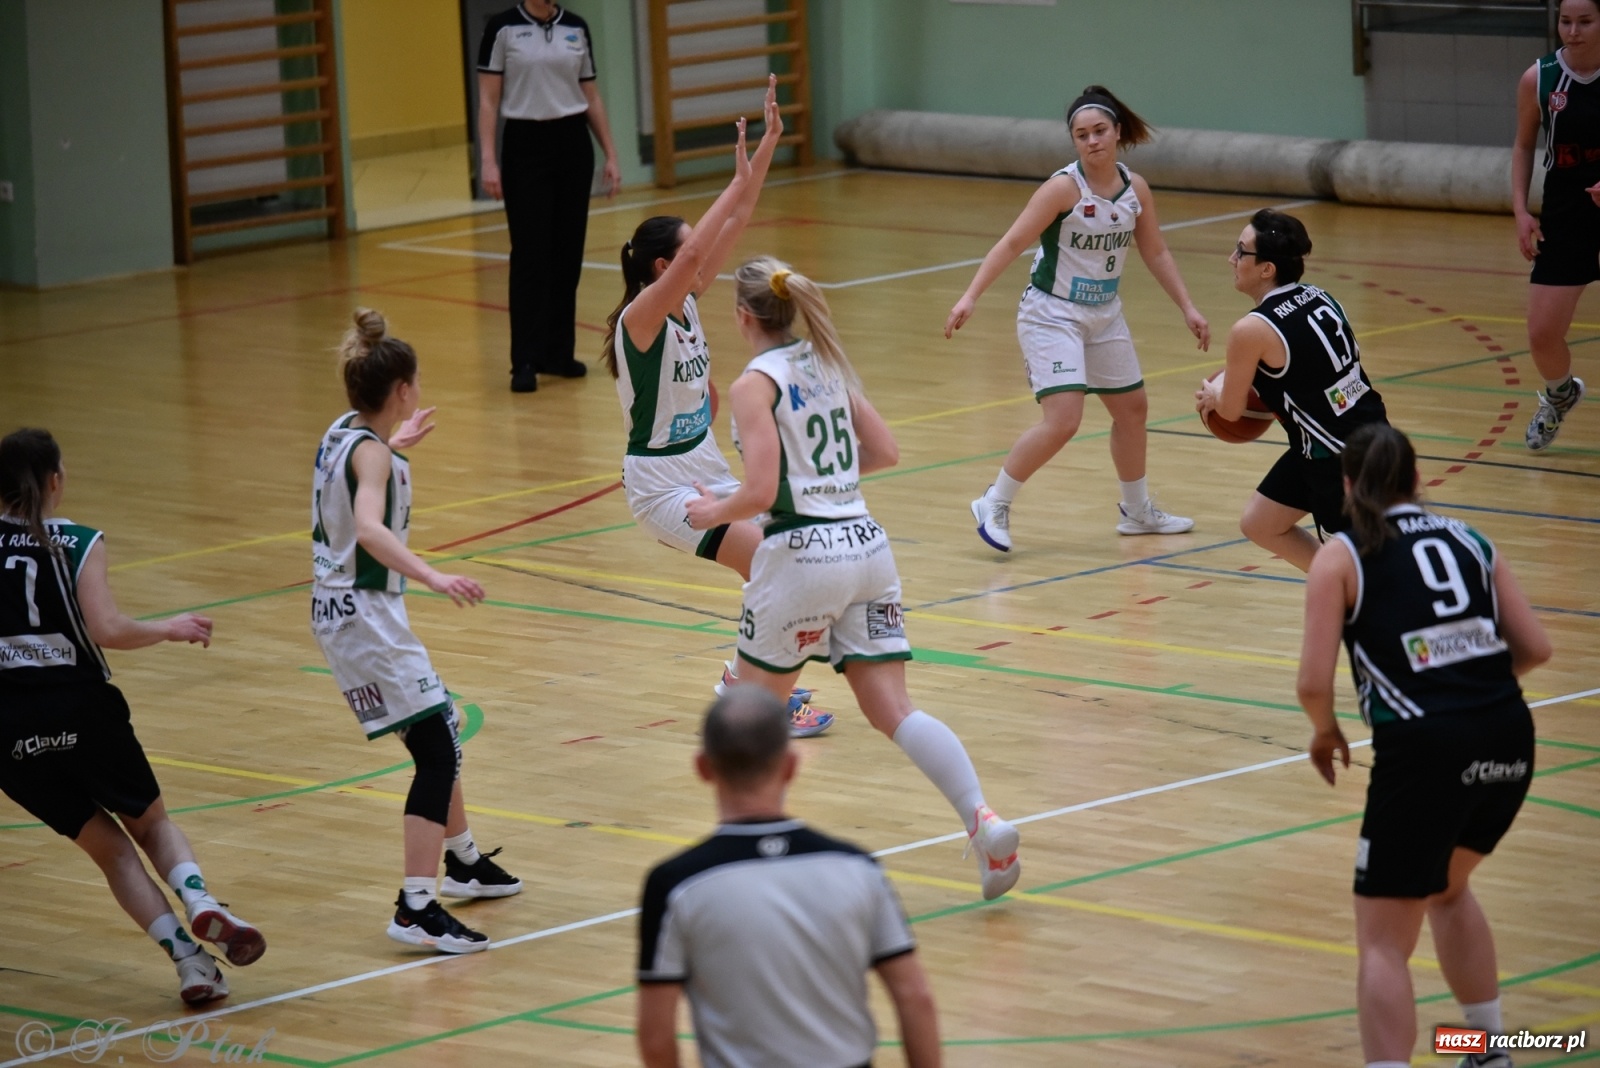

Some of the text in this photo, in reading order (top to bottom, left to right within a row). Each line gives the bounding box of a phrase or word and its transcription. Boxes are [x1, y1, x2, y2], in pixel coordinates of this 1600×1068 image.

[1070, 231, 1133, 252] KATOWI
[1105, 255, 1116, 273] 8
[1076, 281, 1104, 294] max
[1273, 299, 1298, 319] RKK
[1307, 305, 1353, 373] 13
[806, 407, 853, 477] 25
[9, 530, 79, 549] RACÓRZ
[1412, 537, 1470, 618] 9
[5, 555, 41, 627] 7
[0, 647, 72, 663] WAGTECH
[25, 731, 78, 754] Clavis
[1479, 758, 1528, 781] Clavis
